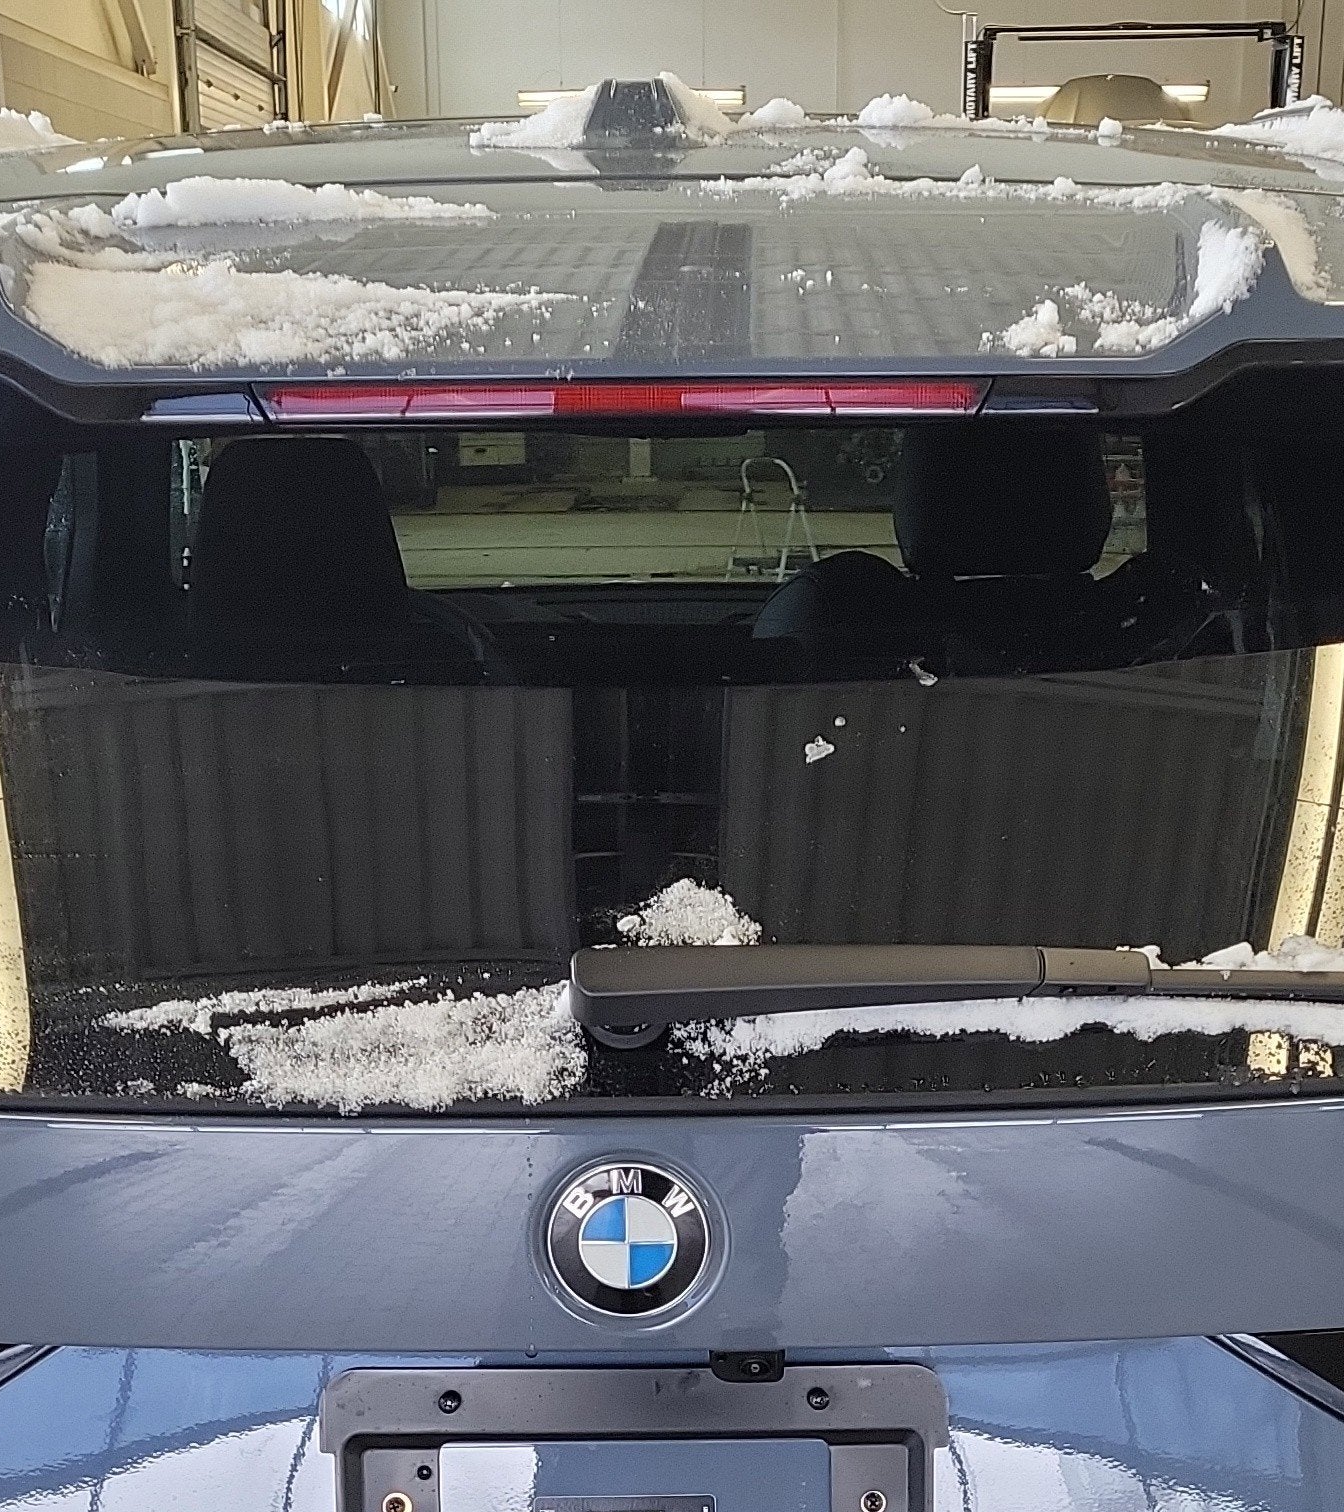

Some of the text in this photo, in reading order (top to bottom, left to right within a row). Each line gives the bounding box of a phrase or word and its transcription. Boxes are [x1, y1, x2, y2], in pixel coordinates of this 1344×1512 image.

[967, 42, 977, 69] LIFT
[1292, 37, 1303, 64] LIFT
[562, 1168, 695, 1219] BMW
